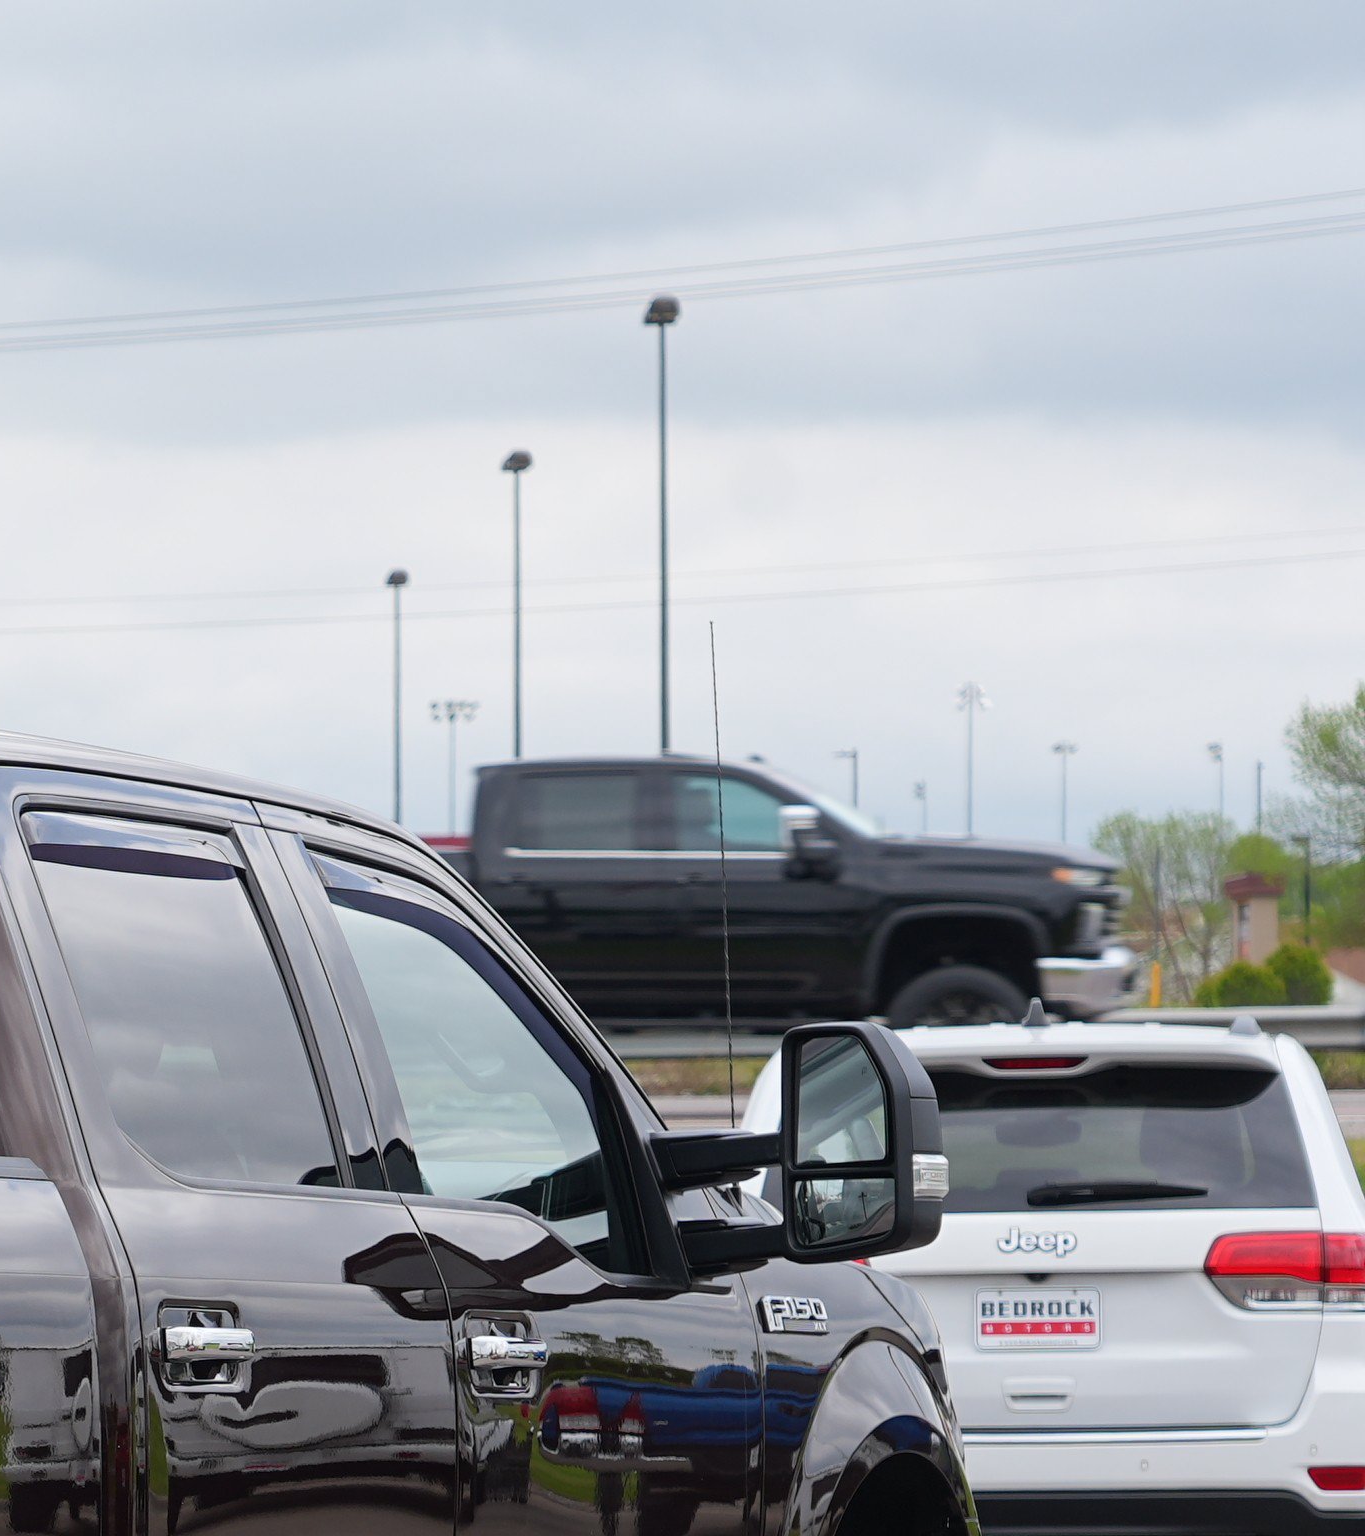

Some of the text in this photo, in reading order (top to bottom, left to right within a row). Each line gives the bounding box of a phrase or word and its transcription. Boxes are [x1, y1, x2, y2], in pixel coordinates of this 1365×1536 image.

[997, 1226, 1077, 1258] Jeep
[981, 1300, 1095, 1317] BEDROCK
[813, 1321, 827, 1332] XLT
[985, 1323, 1091, 1333] MOTORS
